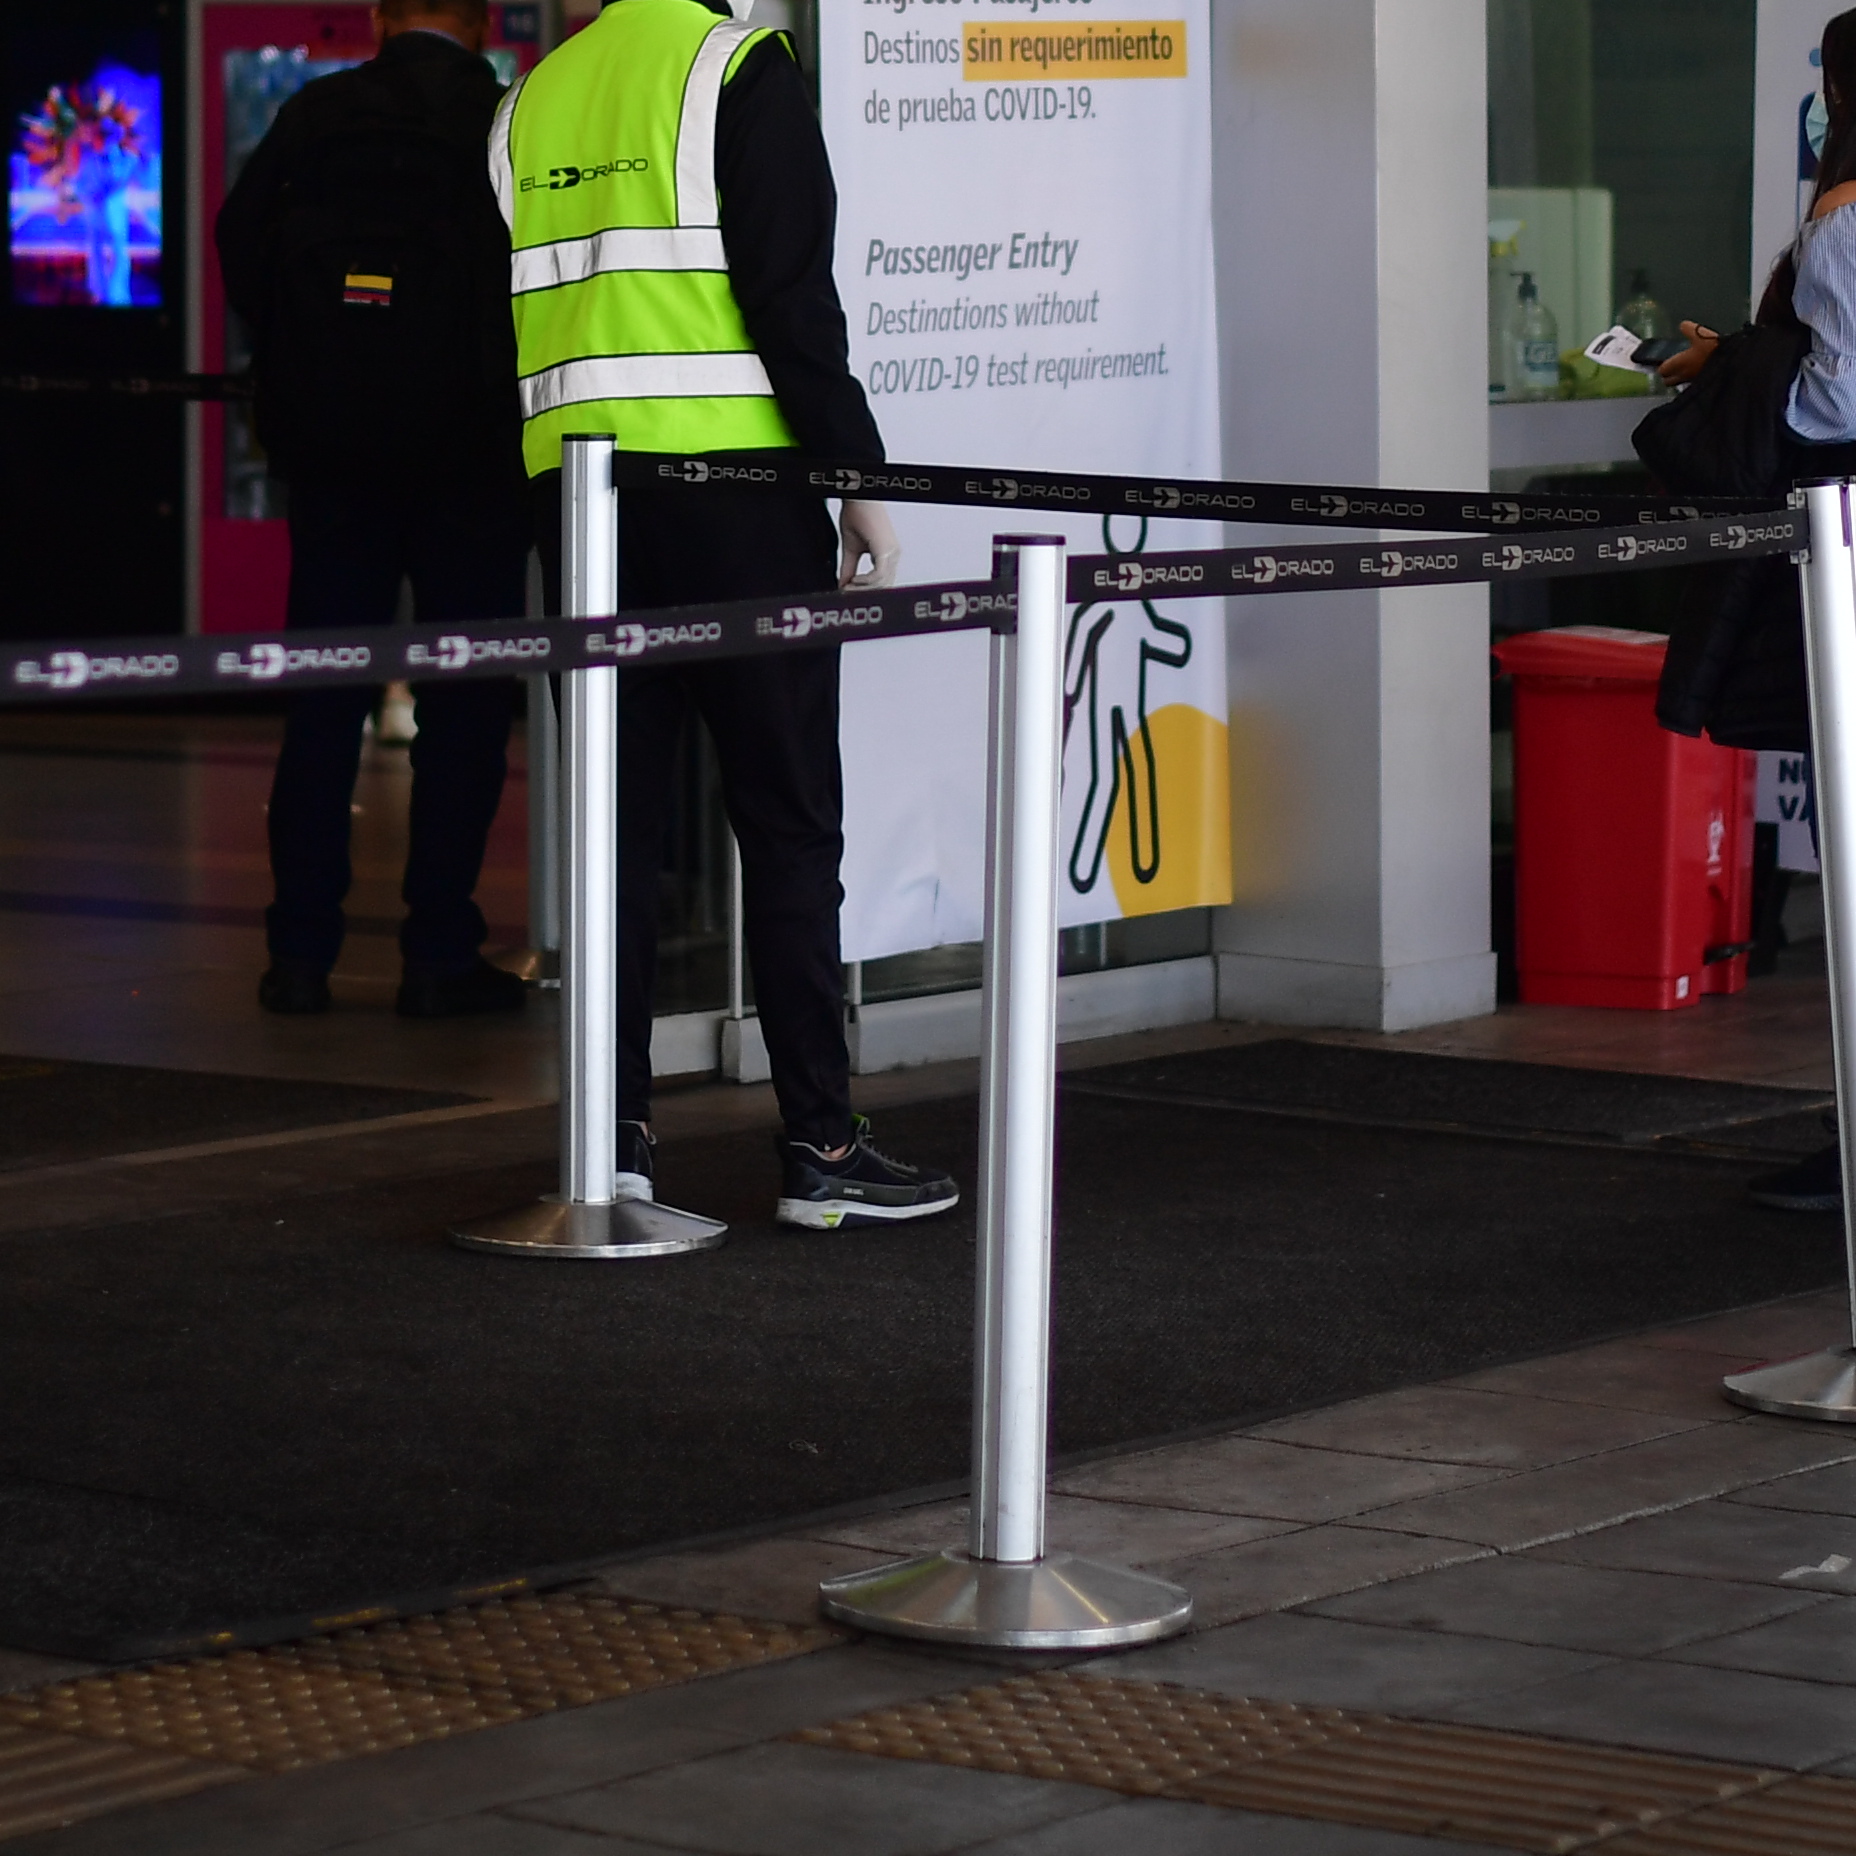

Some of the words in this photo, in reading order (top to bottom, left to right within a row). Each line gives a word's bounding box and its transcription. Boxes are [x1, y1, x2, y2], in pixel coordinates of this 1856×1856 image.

[863, 29, 960, 66] Destinos
[966, 27, 1002, 64] sin
[1009, 26, 1173, 74] requerimiento
[864, 88, 891, 125] de
[898, 88, 977, 132] prueba
[984, 86, 1096, 123] COVID-19.
[865, 236, 1001, 282] Passenger
[1008, 232, 1079, 278] Entry
[867, 293, 1008, 336] Destinations
[1014, 289, 1100, 328] without
[869, 353, 979, 397] COVID-19
[986, 352, 1028, 389] test
[1033, 344, 1169, 391] requirement.
